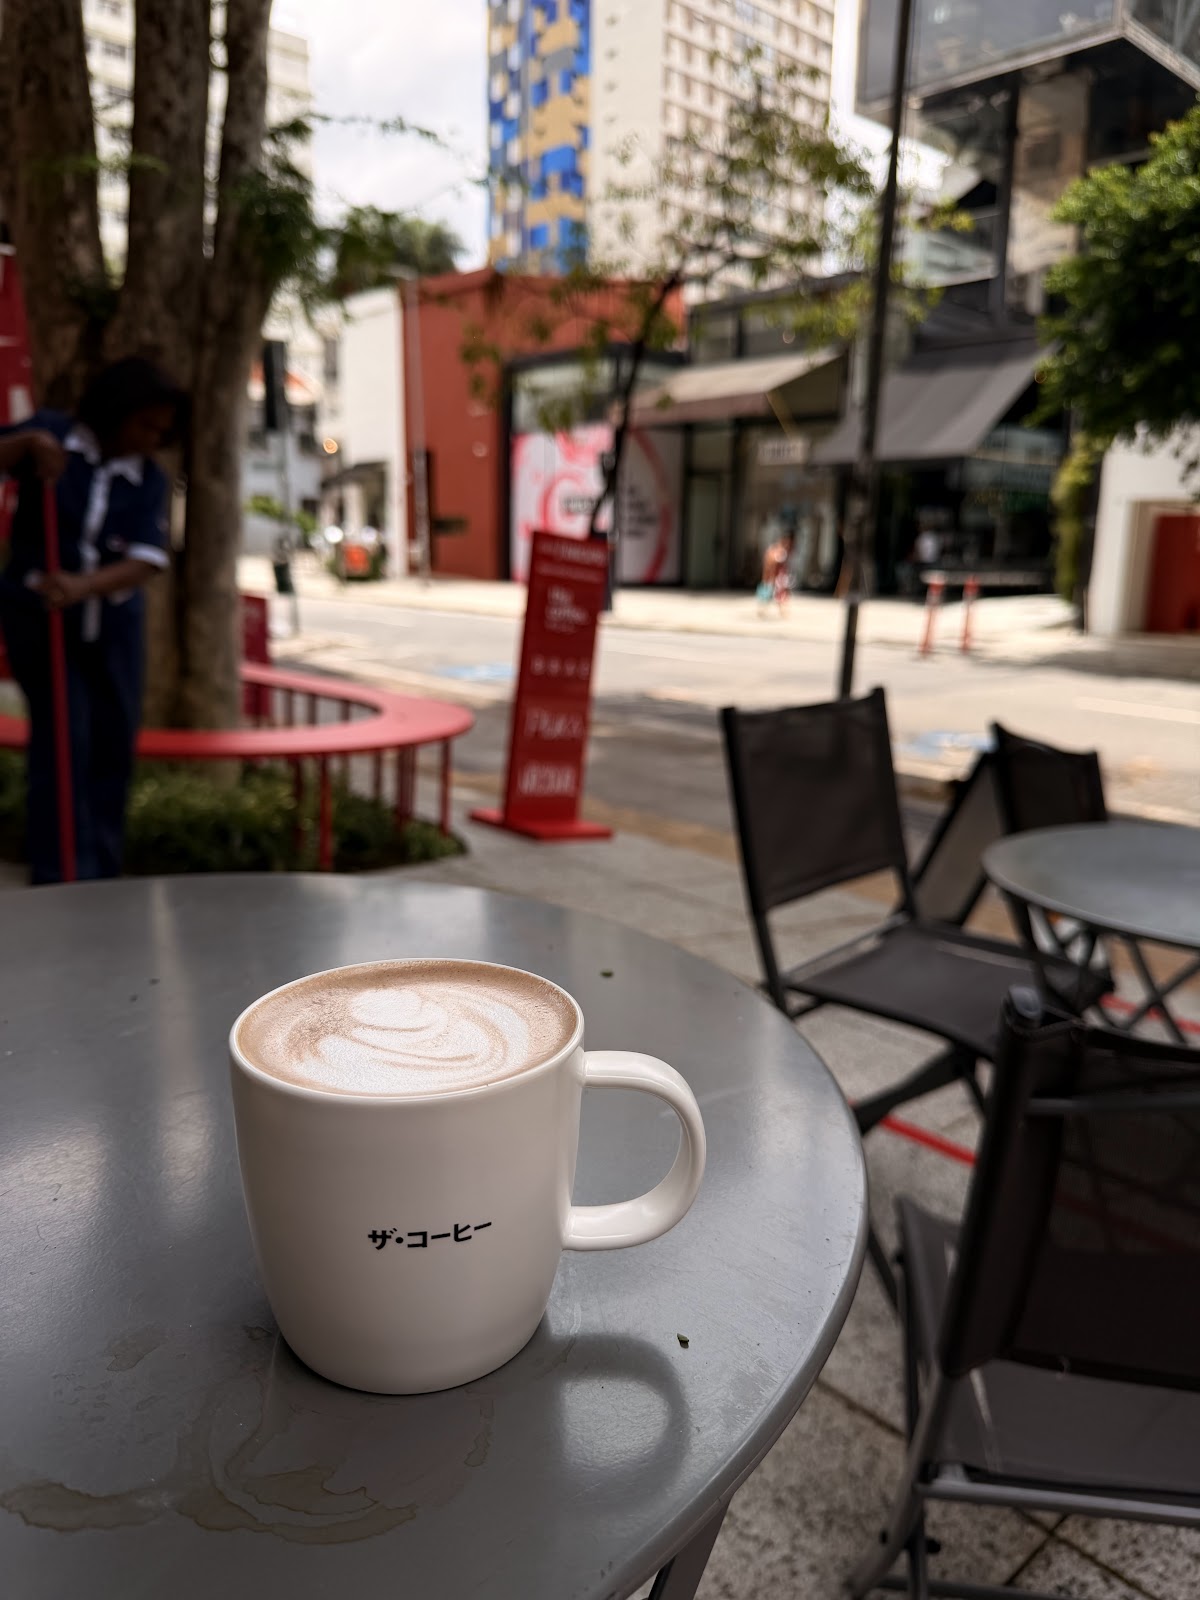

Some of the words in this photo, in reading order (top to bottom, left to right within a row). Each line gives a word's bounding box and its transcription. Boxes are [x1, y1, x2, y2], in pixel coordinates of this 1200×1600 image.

[368, 1221, 492, 1251] ザ・コーヒー
